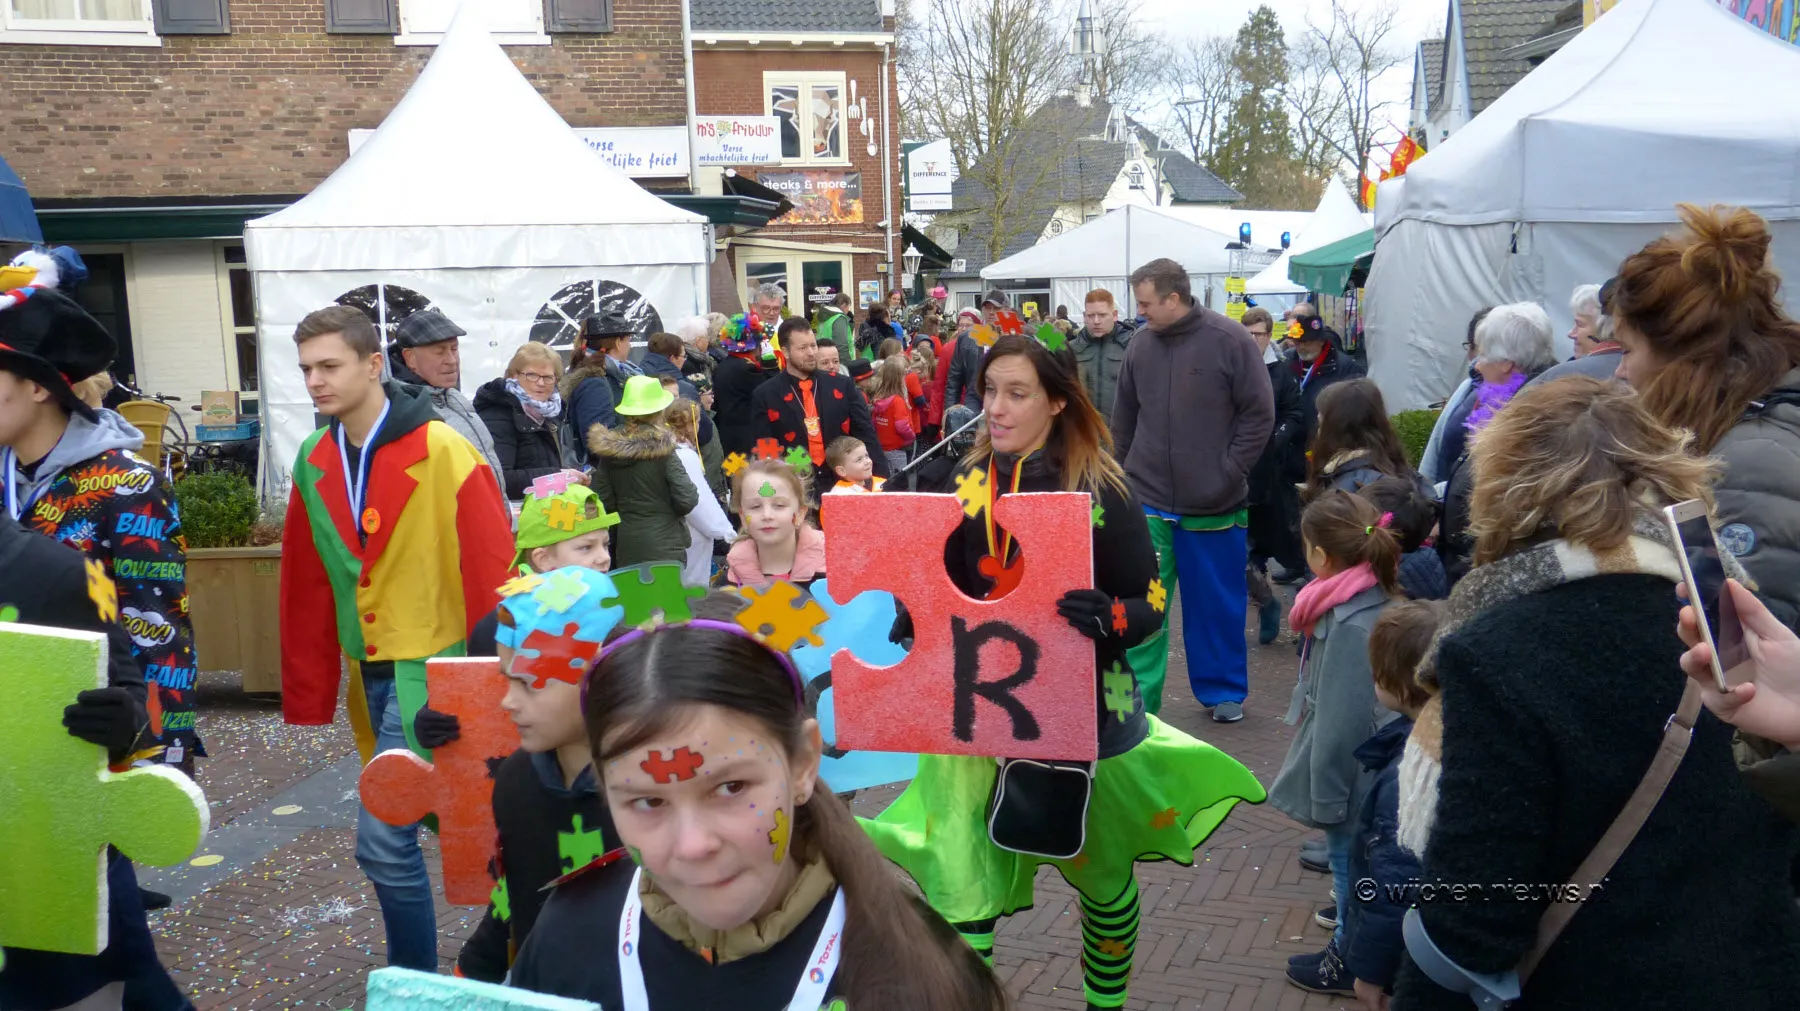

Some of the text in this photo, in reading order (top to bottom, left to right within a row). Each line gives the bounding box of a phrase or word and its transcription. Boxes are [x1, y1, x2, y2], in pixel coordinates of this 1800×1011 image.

[732, 121, 774, 137] frituur
[583, 137, 614, 151] erse
[722, 144, 743, 152] Verse
[649, 152, 678, 169] friet
[752, 153, 769, 164] friet
[763, 180, 800, 190] steaks
[804, 180, 813, 190] &
[115, 512, 180, 541] BAM!
[144, 663, 196, 691] BAM!
[951, 615, 1042, 742] R
[624, 904, 634, 939] TOTAL
[818, 932, 839, 965] TOTAL
